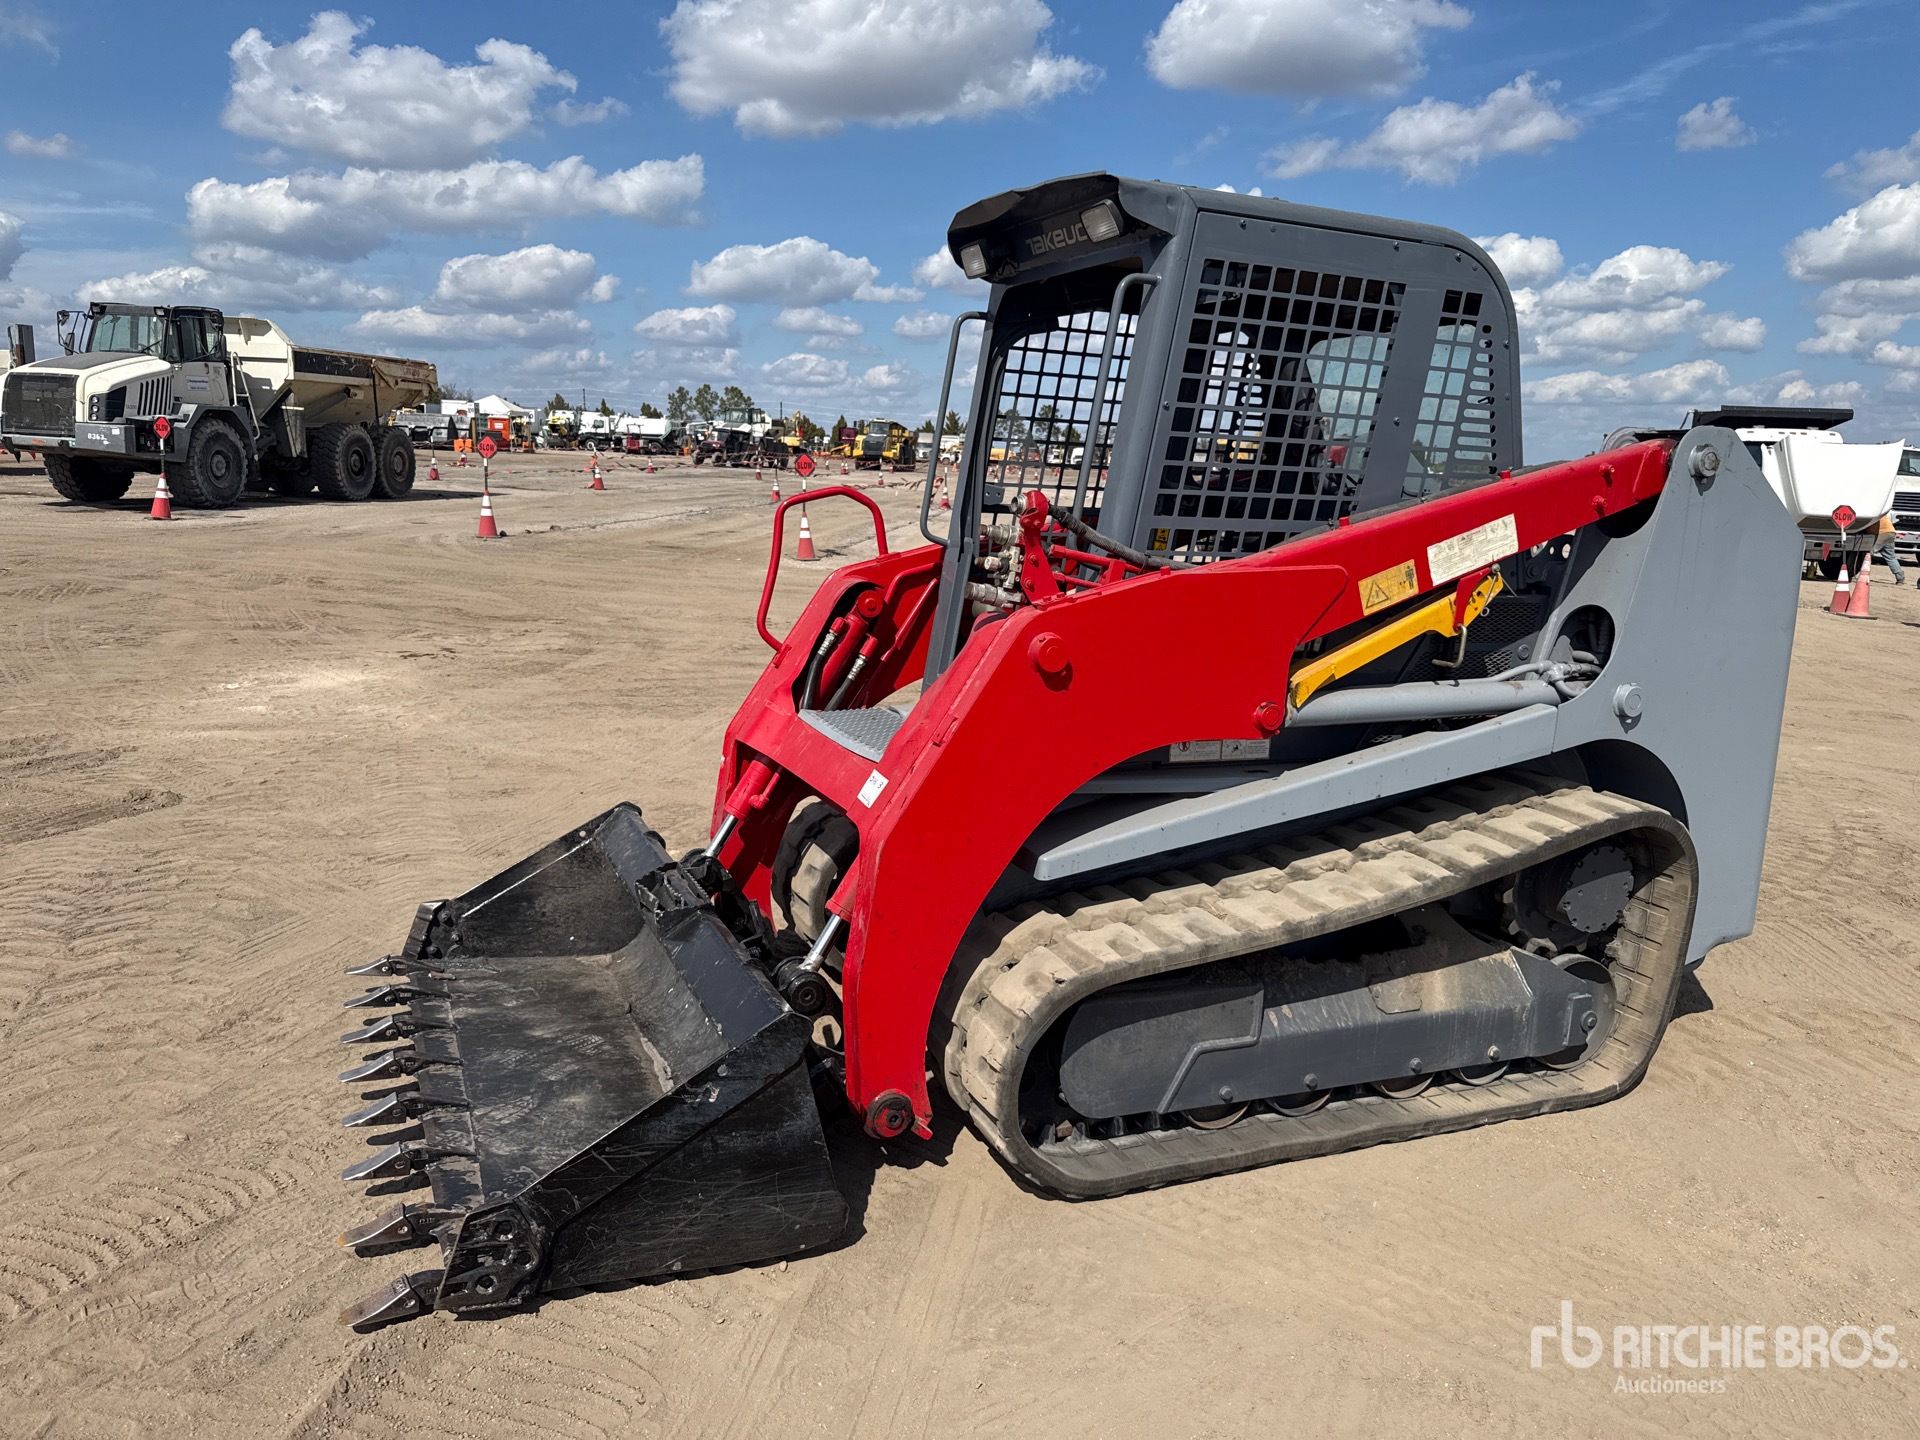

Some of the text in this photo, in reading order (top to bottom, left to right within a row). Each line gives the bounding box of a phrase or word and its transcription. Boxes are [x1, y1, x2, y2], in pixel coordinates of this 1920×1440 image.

[155, 424, 169, 432] SLOW
[479, 443, 495, 451] SLOW
[796, 461, 813, 470] SLOW
[1834, 512, 1853, 521] SLOW
